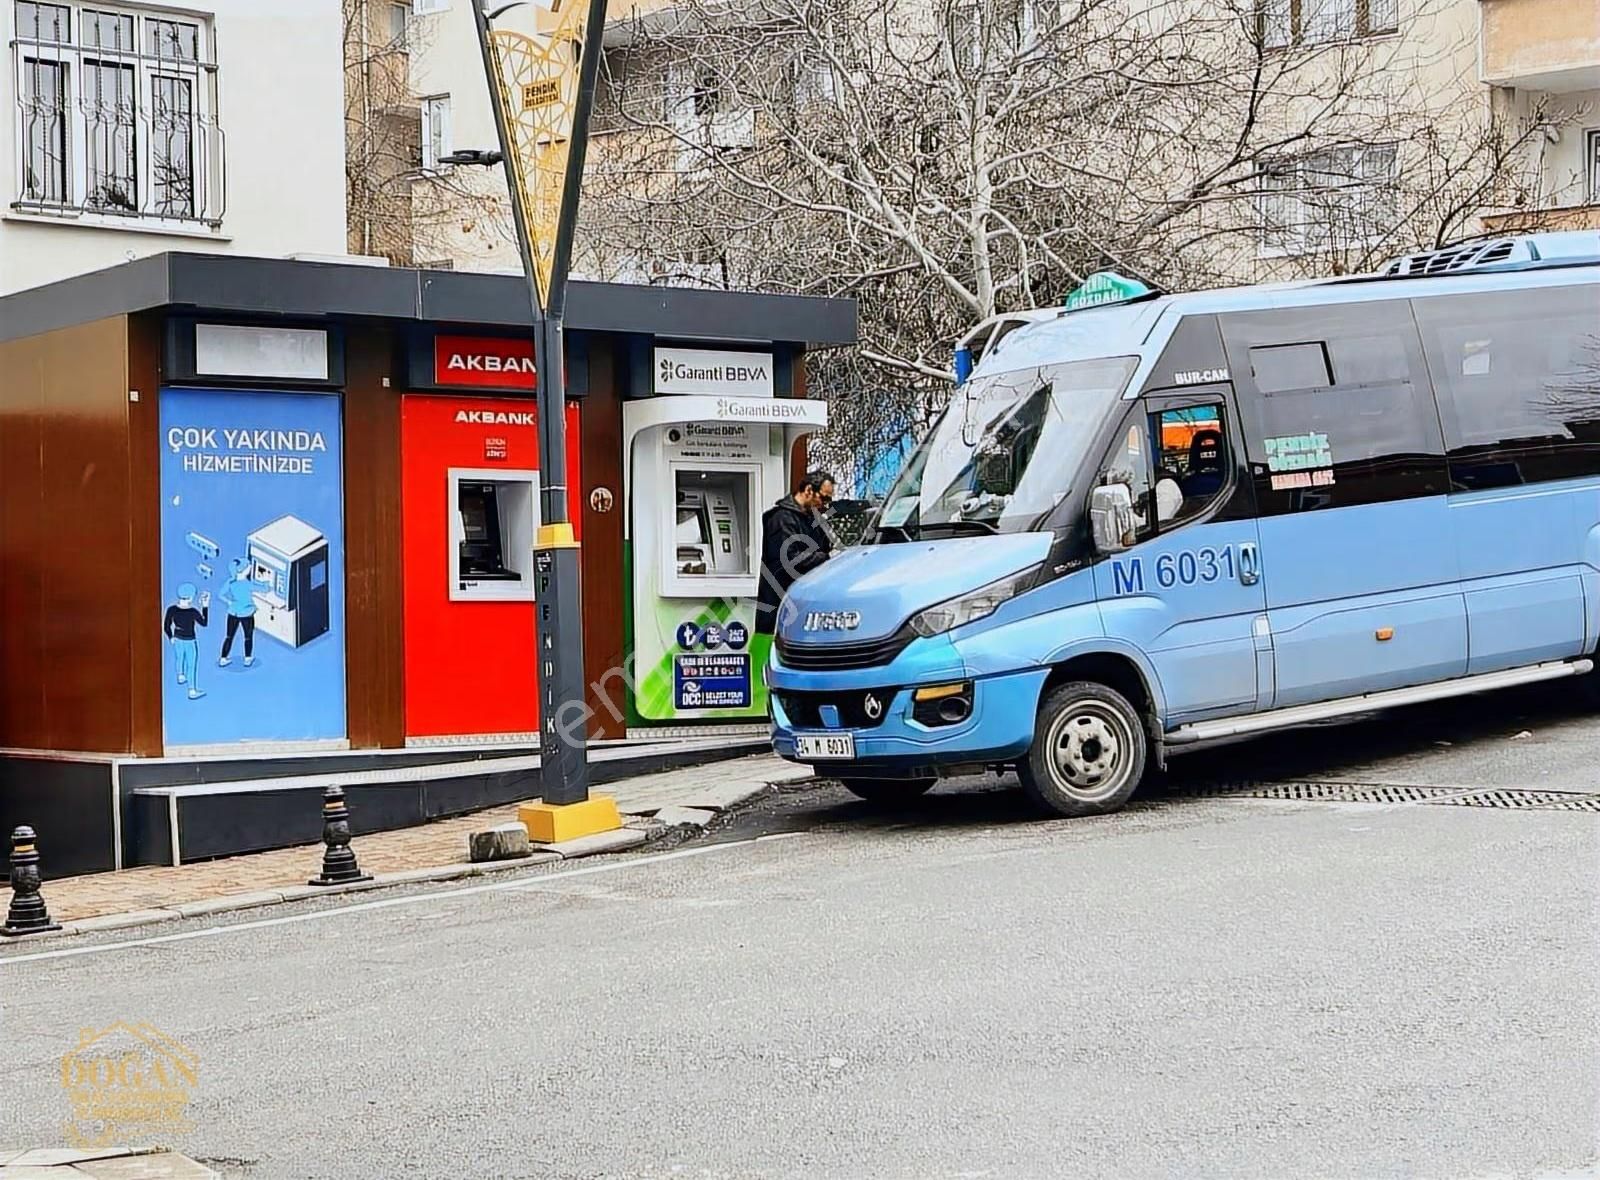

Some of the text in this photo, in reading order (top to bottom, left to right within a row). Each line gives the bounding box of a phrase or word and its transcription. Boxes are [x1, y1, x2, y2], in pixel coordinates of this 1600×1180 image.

[447, 354, 537, 373] AKBAN
[675, 363, 768, 382] Garanti BBVA
[455, 410, 535, 425] AKBANK
[729, 403, 808, 418] Garanti BBVA
[167, 427, 326, 453] ÇOK YAKINDA
[183, 453, 313, 474] HİZMETİNİZDE
[1112, 543, 1235, 594] M 6031
[682, 692, 701, 706] DCC
[827, 735, 850, 755] 6031
